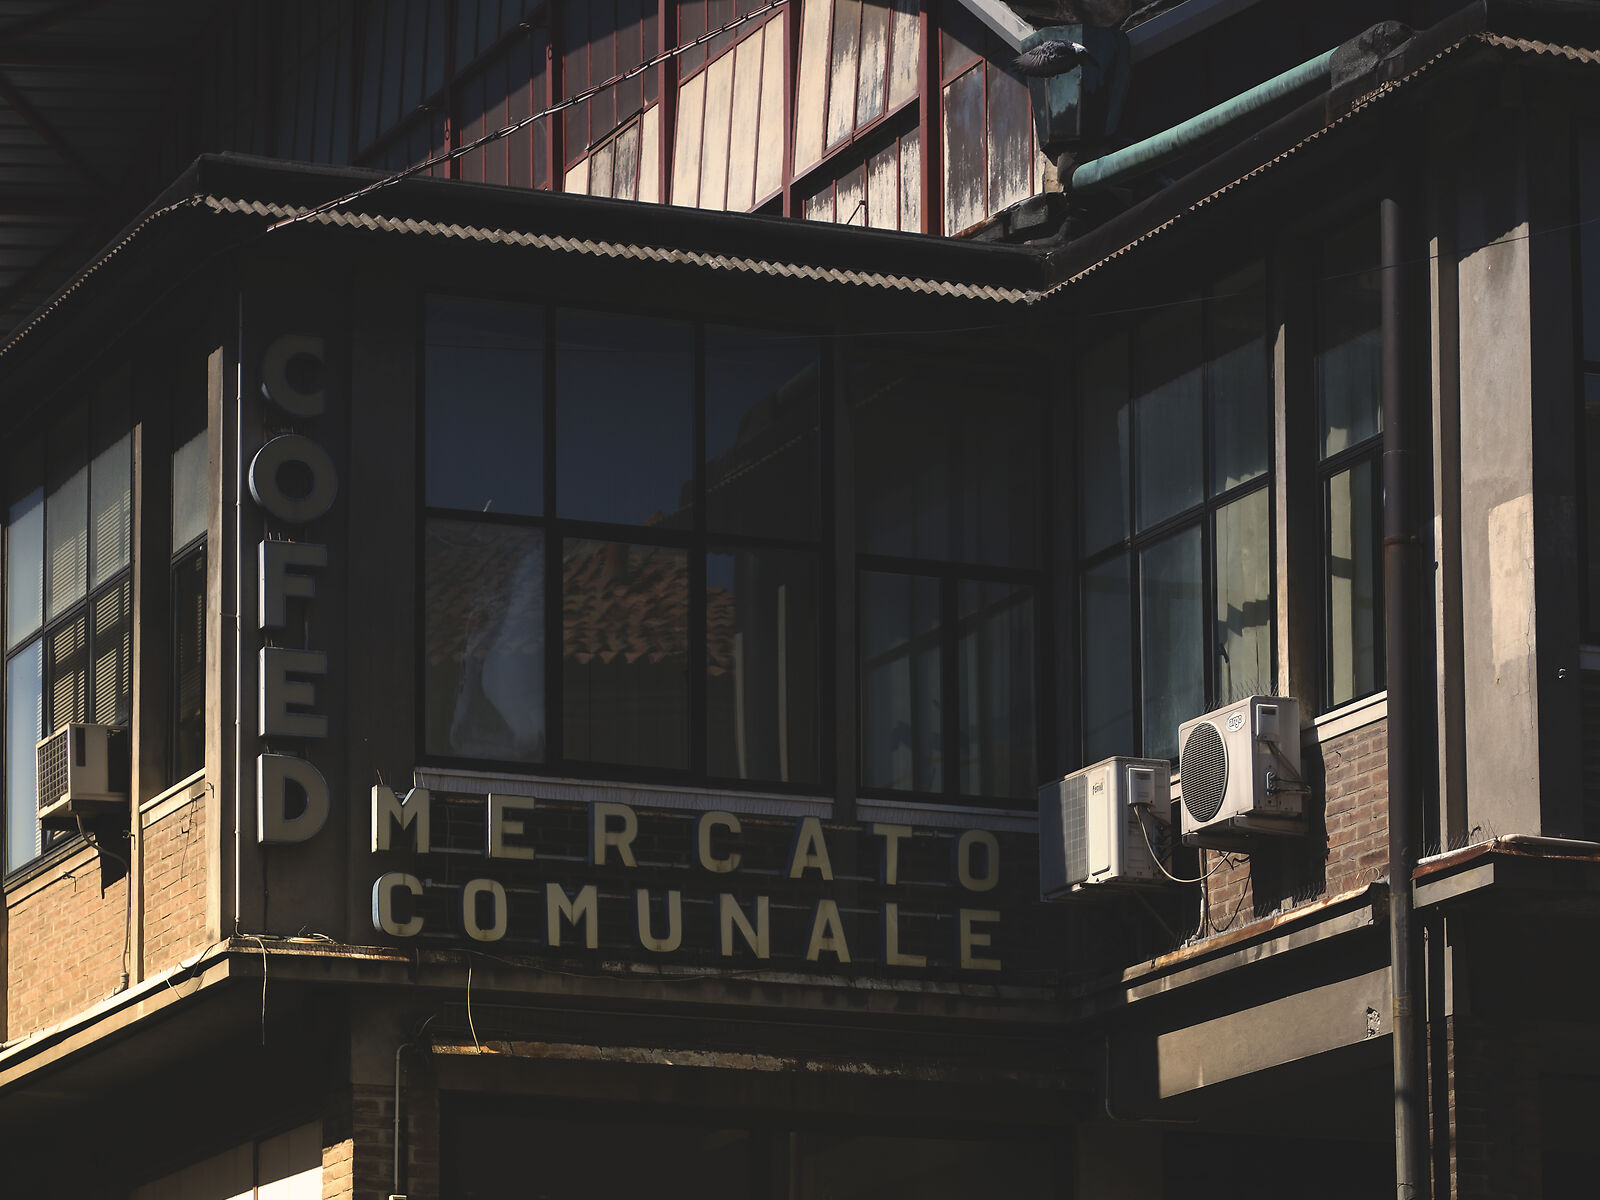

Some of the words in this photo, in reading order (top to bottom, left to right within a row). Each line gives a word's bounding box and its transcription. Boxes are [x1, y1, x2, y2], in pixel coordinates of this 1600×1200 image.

[248, 334, 338, 846] COFED
[372, 784, 1000, 893] MERCATO
[372, 872, 1000, 971] COMUNALE
